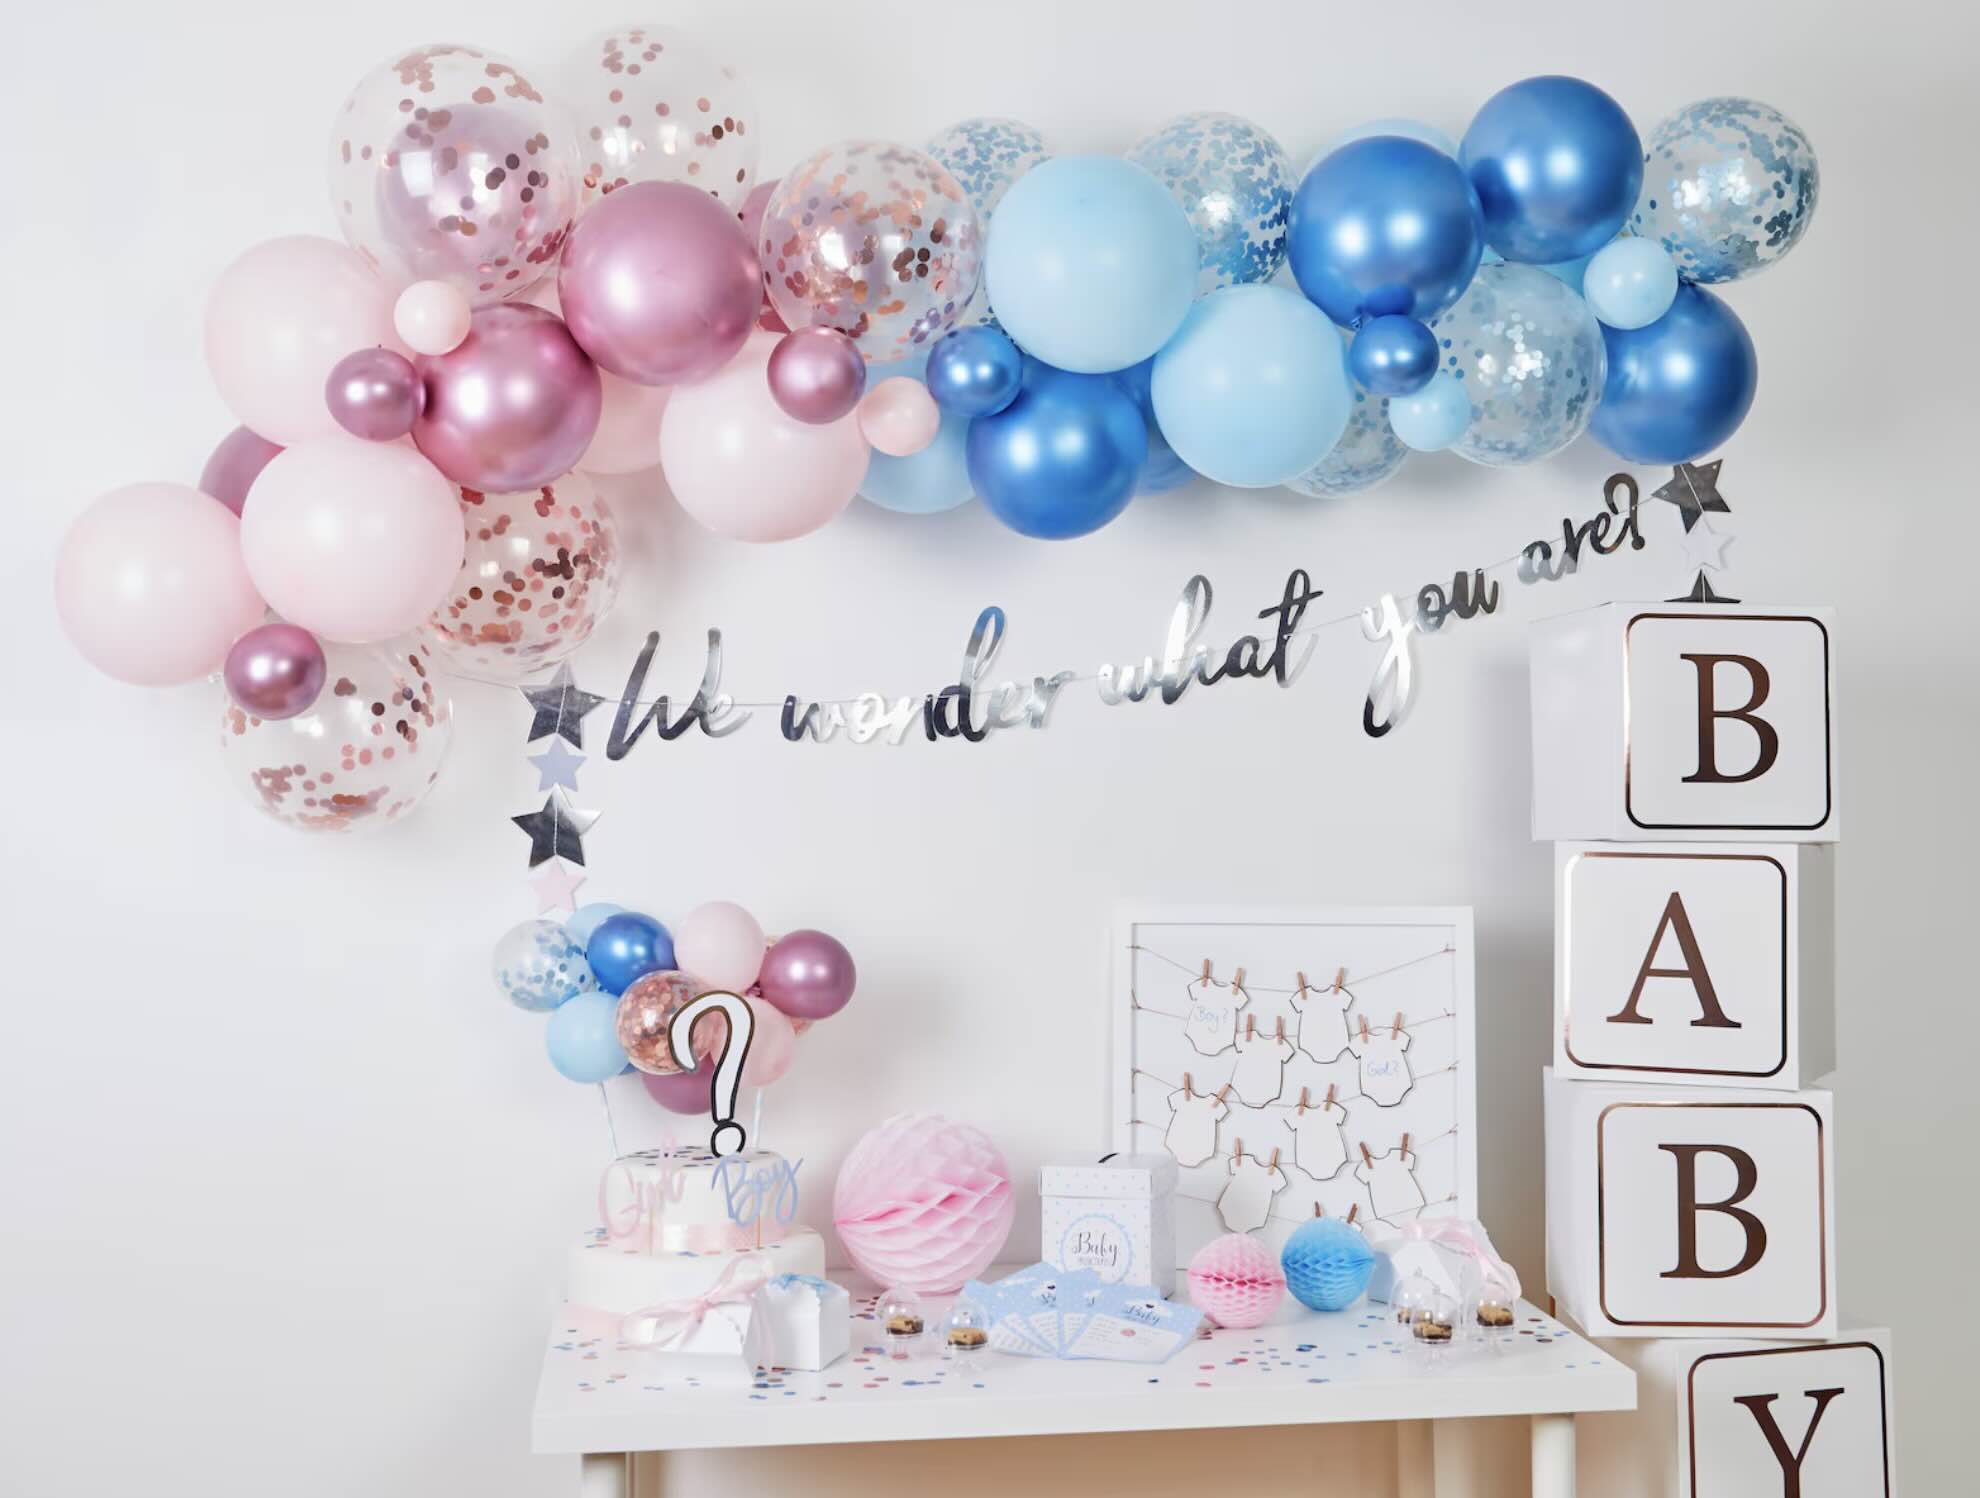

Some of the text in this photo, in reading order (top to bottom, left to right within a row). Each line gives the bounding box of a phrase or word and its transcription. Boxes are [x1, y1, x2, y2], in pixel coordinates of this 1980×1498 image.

[606, 472, 1646, 761] We wonder what you are?
[1680, 652, 1779, 784] B
[1606, 891, 1742, 1029] A
[711, 1152, 804, 1227] Boy
[1658, 1143, 1767, 1279] B
